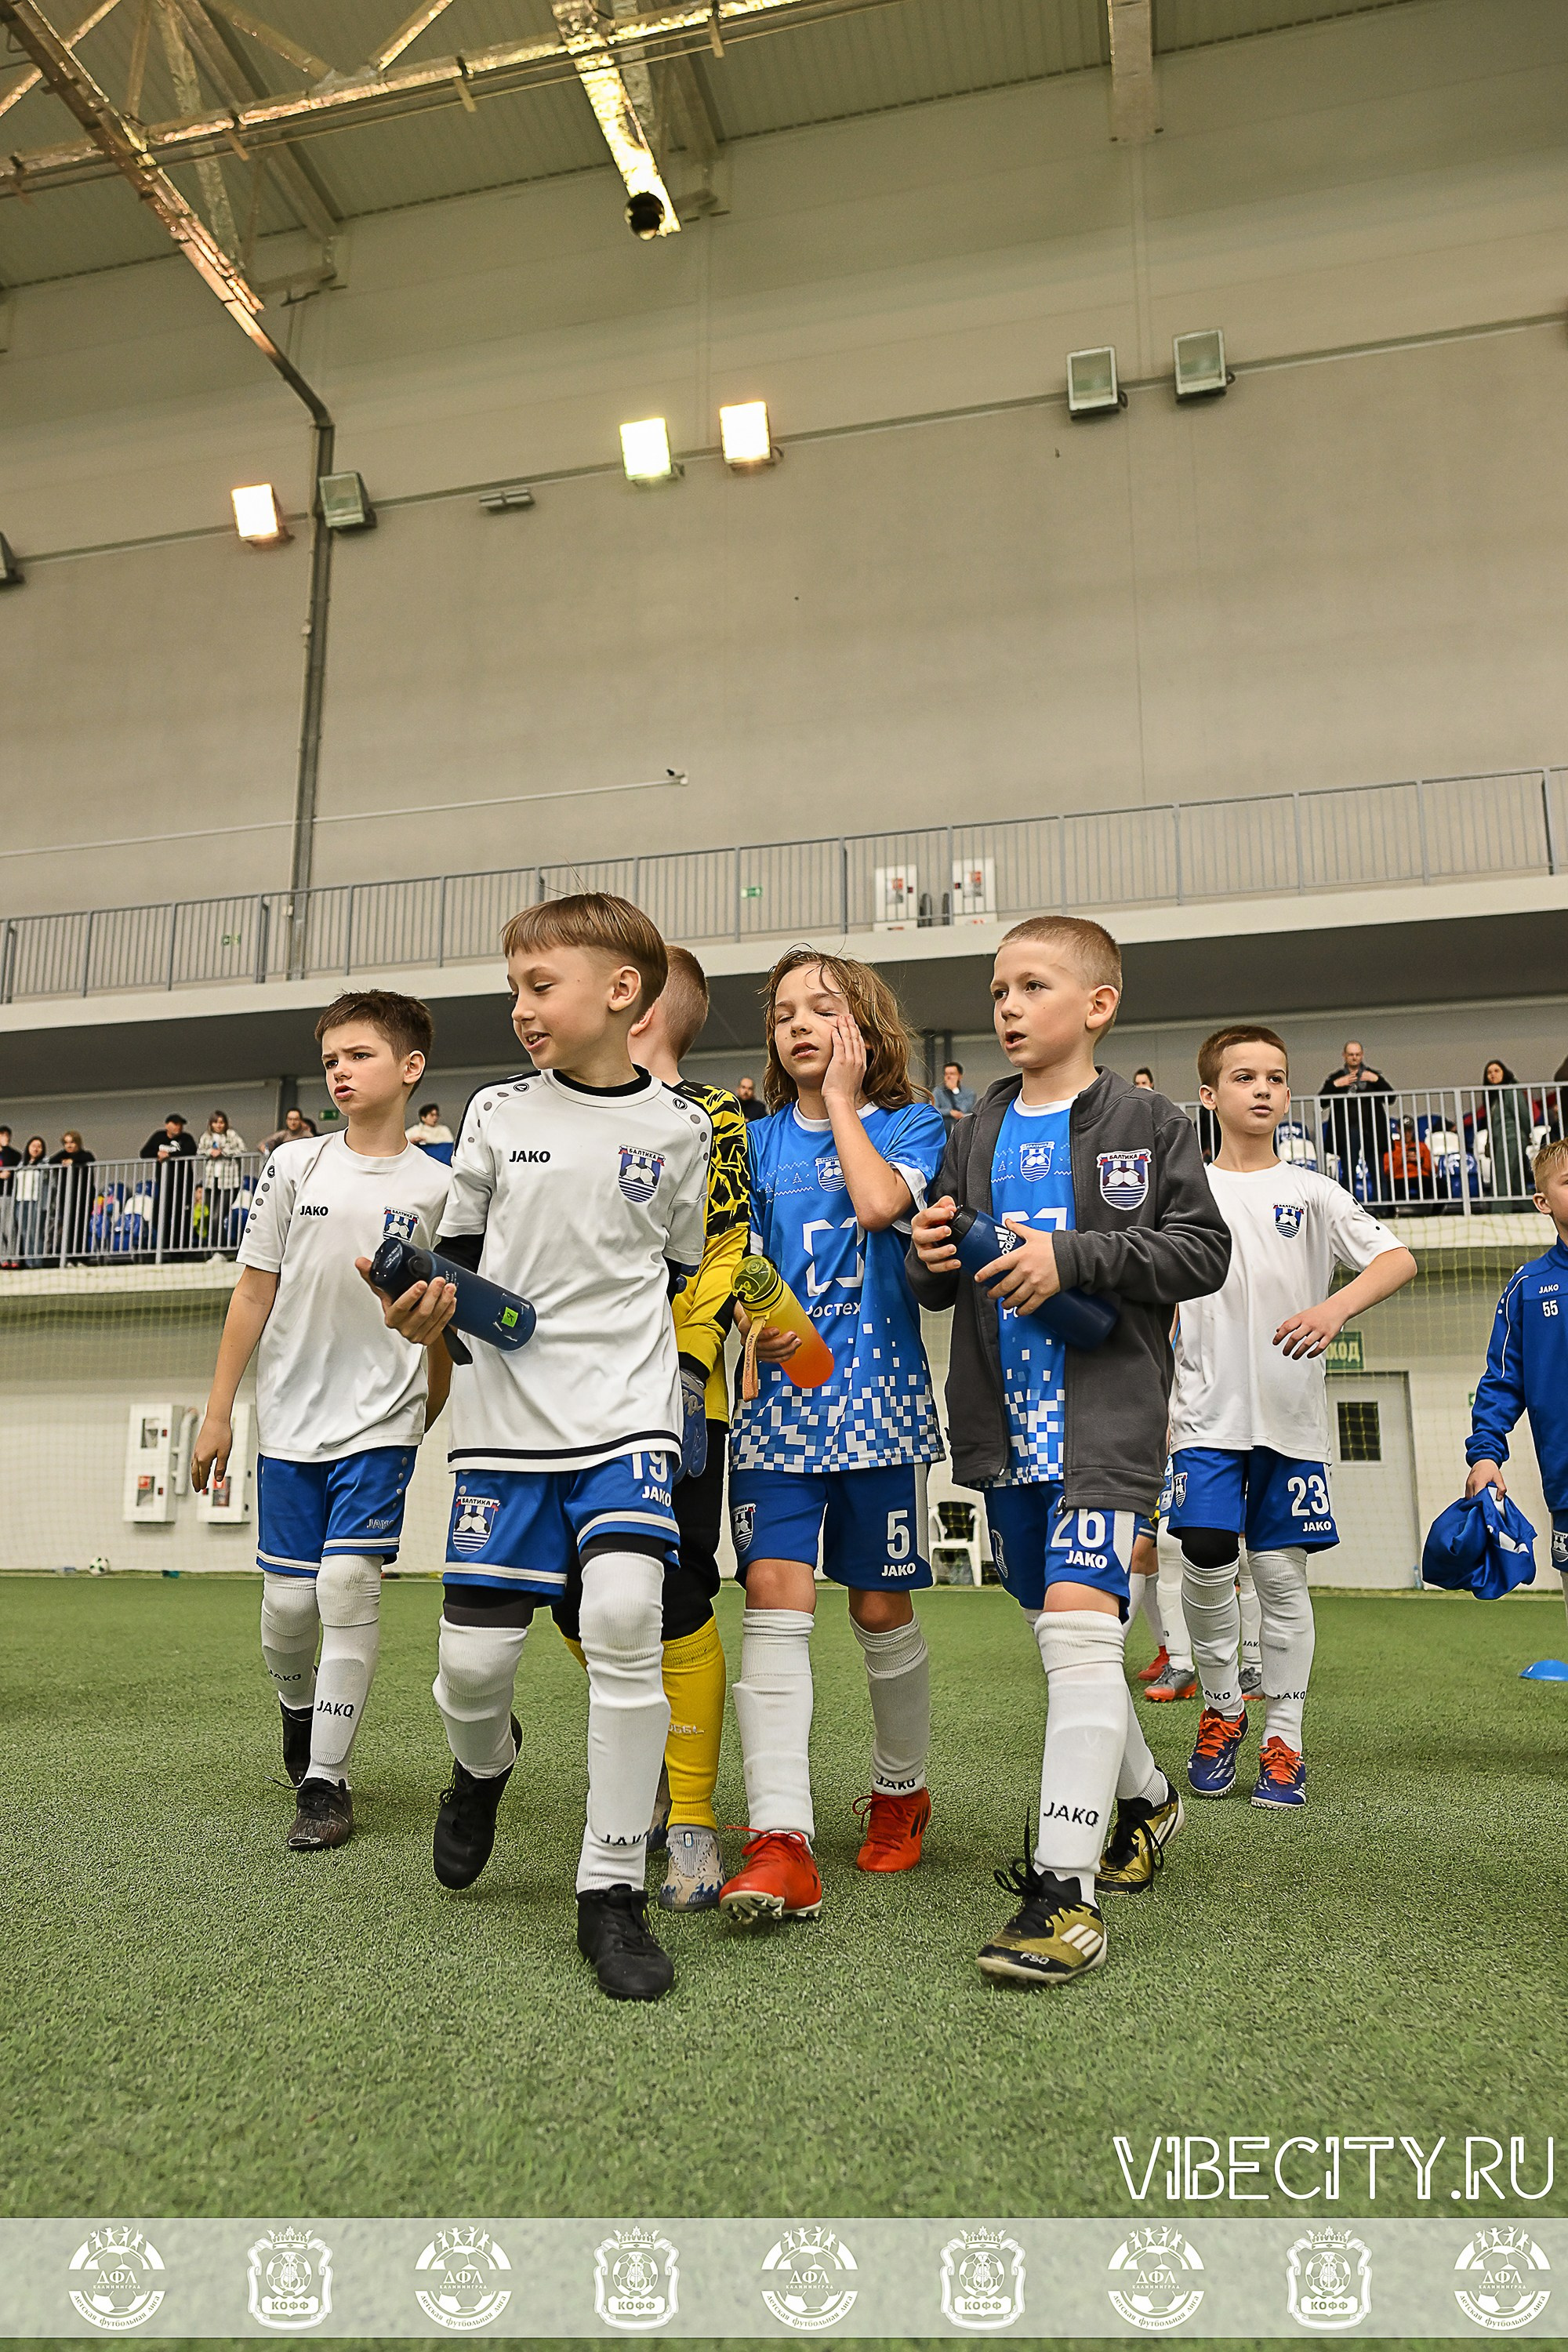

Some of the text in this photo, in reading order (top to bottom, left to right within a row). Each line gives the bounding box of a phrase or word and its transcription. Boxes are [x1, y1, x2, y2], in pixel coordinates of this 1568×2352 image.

[509, 1150, 551, 1163] JAKO
[629, 1148, 657, 1160] БАЛТИКА
[299, 1205, 328, 1217] JAKO
[1001, 1231, 1018, 1255] adida
[1539, 1284, 1559, 1294] JAKO
[1542, 1300, 1559, 1317] 55
[1326, 1341, 1360, 1363] ХОД
[632, 1452, 668, 1483] 19
[462, 1497, 492, 1506] БАЛТИКА
[642, 1485, 672, 1508] JAKO
[1287, 1475, 1330, 1517] 23
[887, 1509, 909, 1559] 5
[1051, 1507, 1106, 1548] 26
[1302, 1521, 1332, 1532] JAKO
[1065, 1550, 1108, 1569] JAKO
[881, 1562, 916, 1577] JAKO
[1205, 1690, 1231, 1700] AKO
[1273, 1691, 1306, 1700] JAKO
[317, 1700, 354, 1719] JAKO
[1044, 1802, 1099, 1828] JAKO
